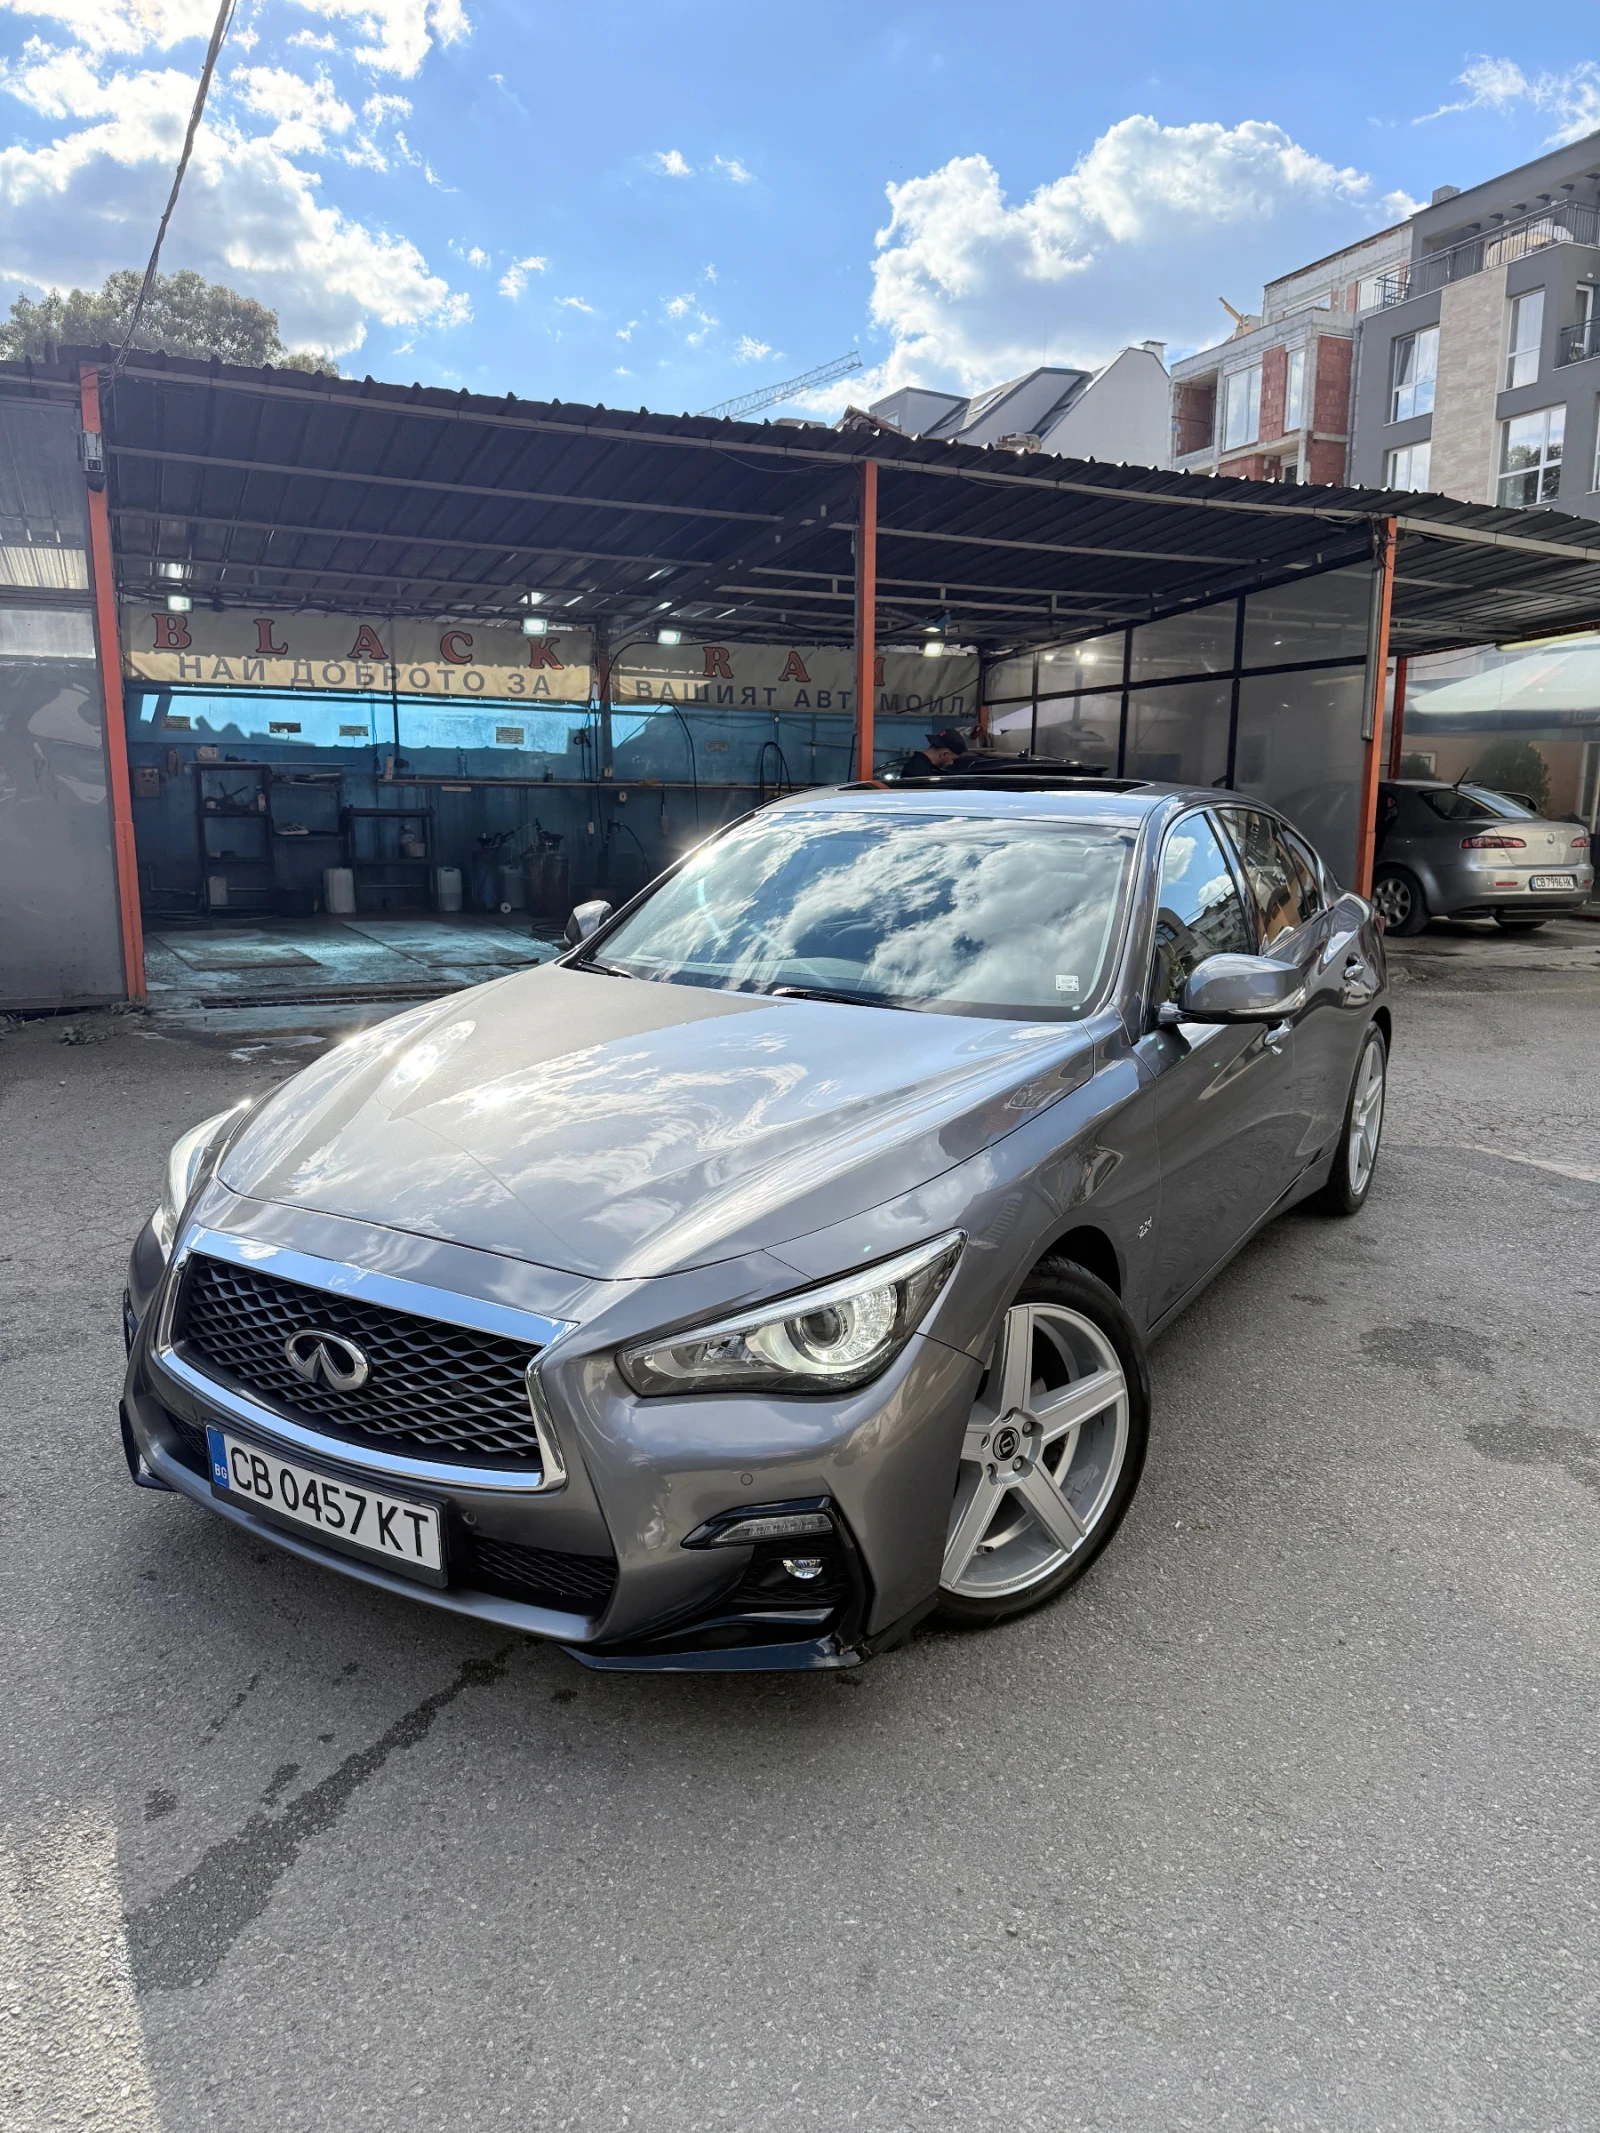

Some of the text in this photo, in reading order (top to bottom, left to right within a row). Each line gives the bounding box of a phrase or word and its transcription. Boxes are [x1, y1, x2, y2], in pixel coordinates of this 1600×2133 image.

[152, 612, 564, 670] BLACK
[290, 661, 485, 692] ДОБРОТО
[507, 673, 552, 696] ЗА
[635, 680, 777, 707] ВАШИЯТ
[214, 1462, 228, 1480] BG
[279, 1468, 367, 1535] 0457
